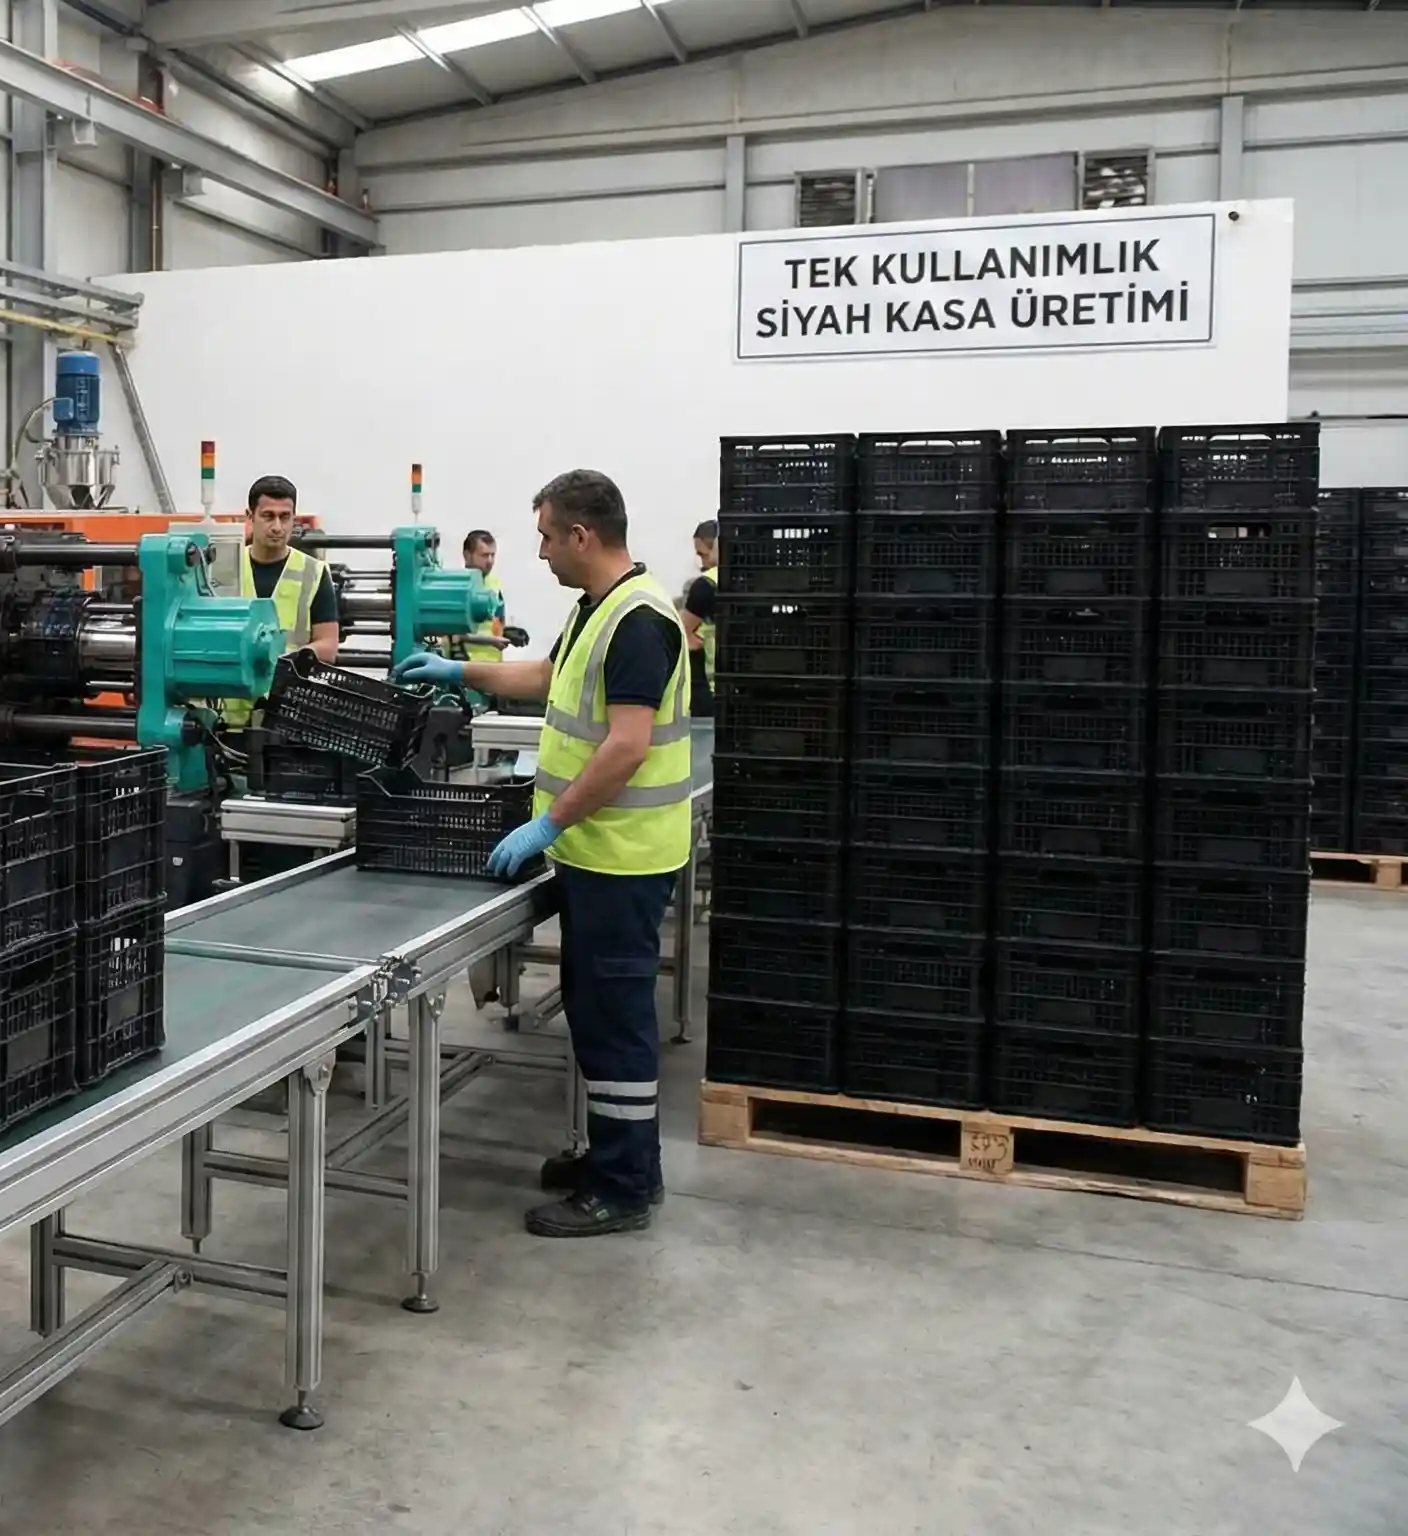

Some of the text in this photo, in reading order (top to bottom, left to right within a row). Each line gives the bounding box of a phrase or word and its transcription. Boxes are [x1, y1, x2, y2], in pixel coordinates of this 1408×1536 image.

[784, 238, 1160, 290] TEK KULLANIMLIK
[756, 280, 1189, 338] SİYAH KASA ÜRETİMİ
